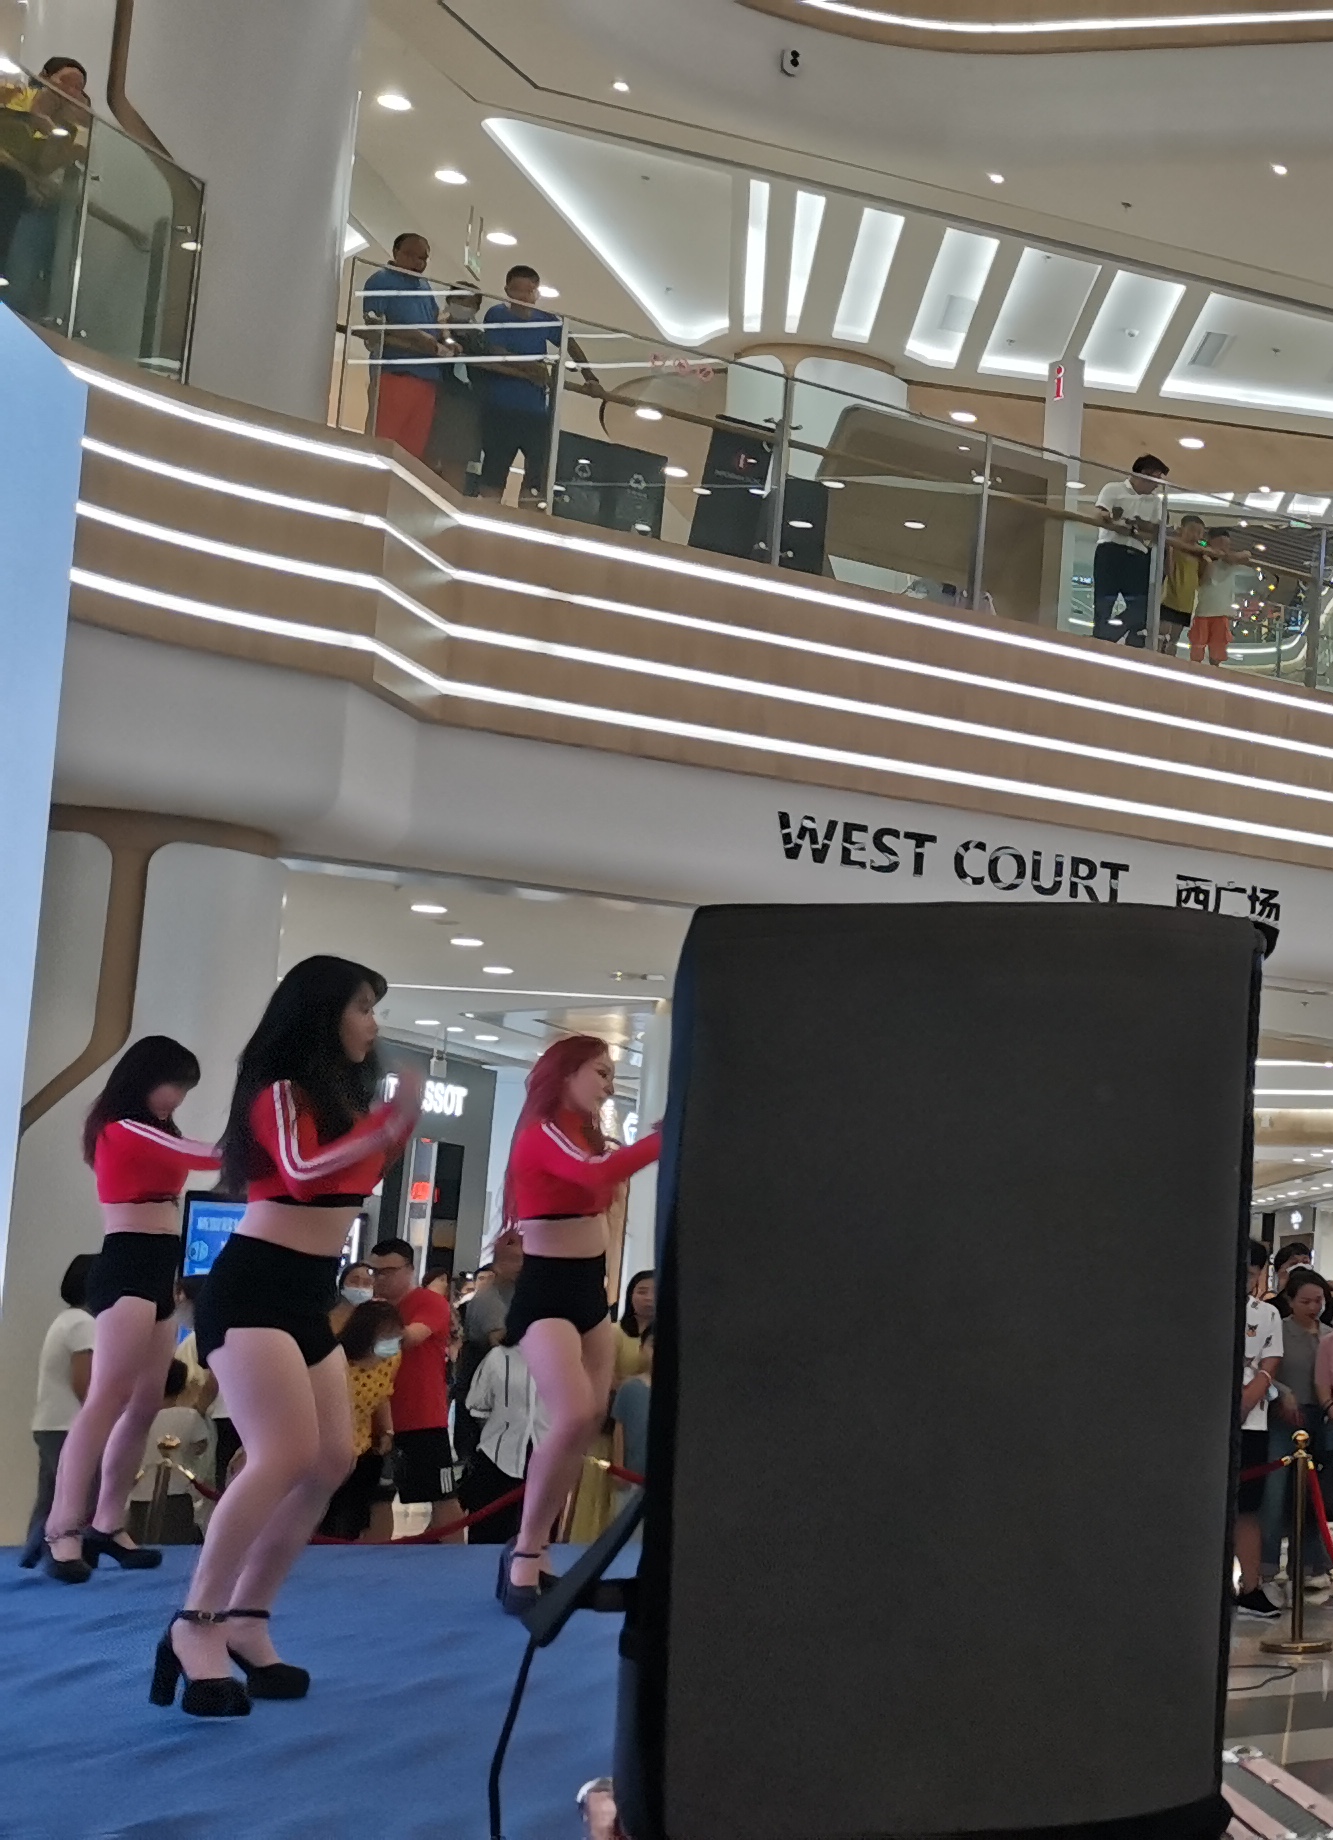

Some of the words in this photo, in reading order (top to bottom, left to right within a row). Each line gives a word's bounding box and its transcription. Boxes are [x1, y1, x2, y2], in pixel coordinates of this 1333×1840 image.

[777, 811, 937, 877] WEST
[954, 840, 1130, 903] COURT
[1176, 873, 1281, 927] 西广场
